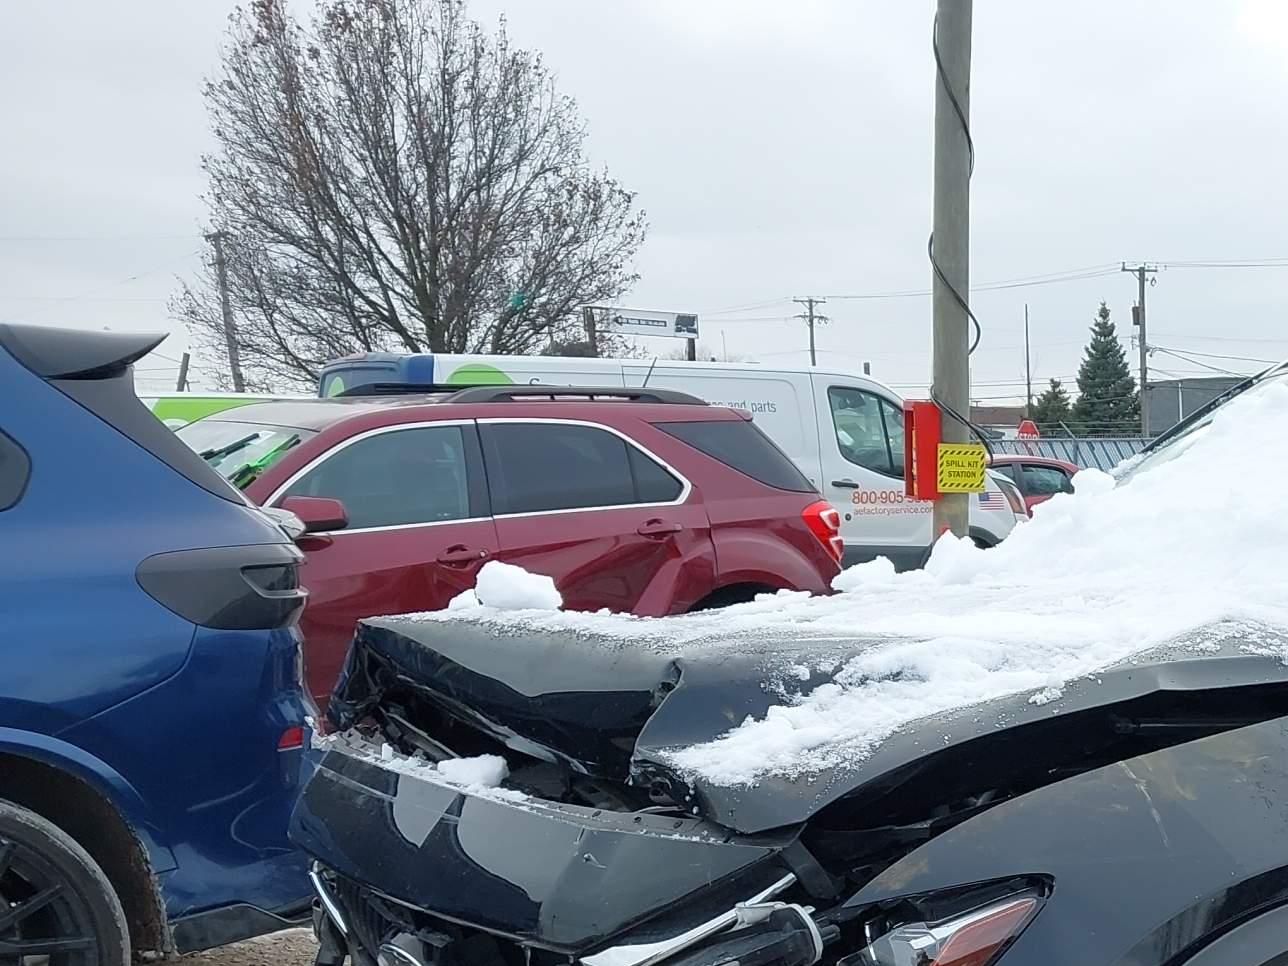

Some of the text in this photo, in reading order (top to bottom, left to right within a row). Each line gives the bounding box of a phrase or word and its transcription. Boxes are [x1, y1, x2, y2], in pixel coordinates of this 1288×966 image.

[751, 400, 777, 413] parts
[945, 460, 979, 468] SPILL KIT
[947, 470, 977, 478] STATION
